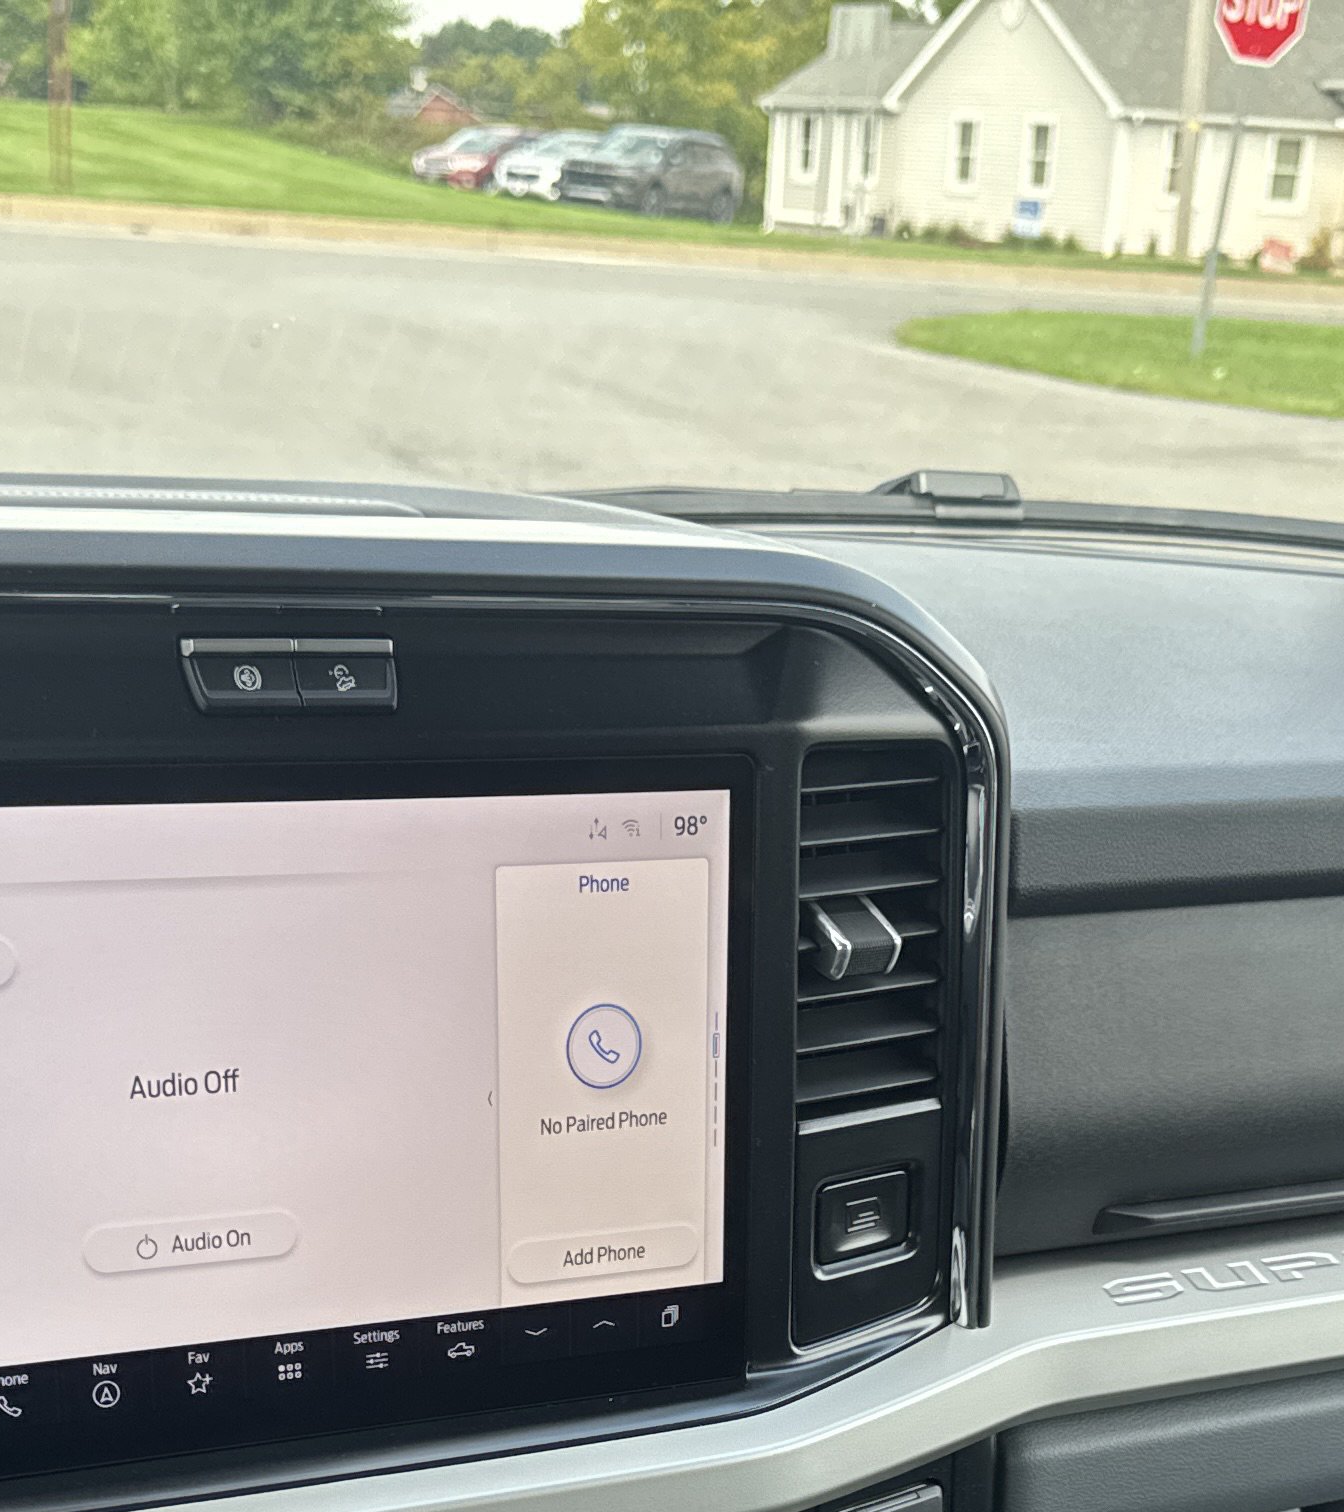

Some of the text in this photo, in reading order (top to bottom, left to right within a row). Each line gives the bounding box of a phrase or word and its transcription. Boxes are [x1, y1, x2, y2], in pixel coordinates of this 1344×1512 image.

[1222, 0, 1300, 30] STOP
[673, 815, 708, 836] 98°
[578, 875, 630, 893] Phone
[129, 1068, 240, 1100] Audio Off
[540, 1110, 667, 1135] No Paired Phone
[172, 1229, 252, 1254] Audio On
[562, 1244, 646, 1267] Add Phone
[436, 1319, 485, 1335] Features
[353, 1328, 400, 1346] Settings
[187, 1350, 211, 1365] Fav
[274, 1340, 305, 1356] Apps
[92, 1361, 118, 1376] Nav
